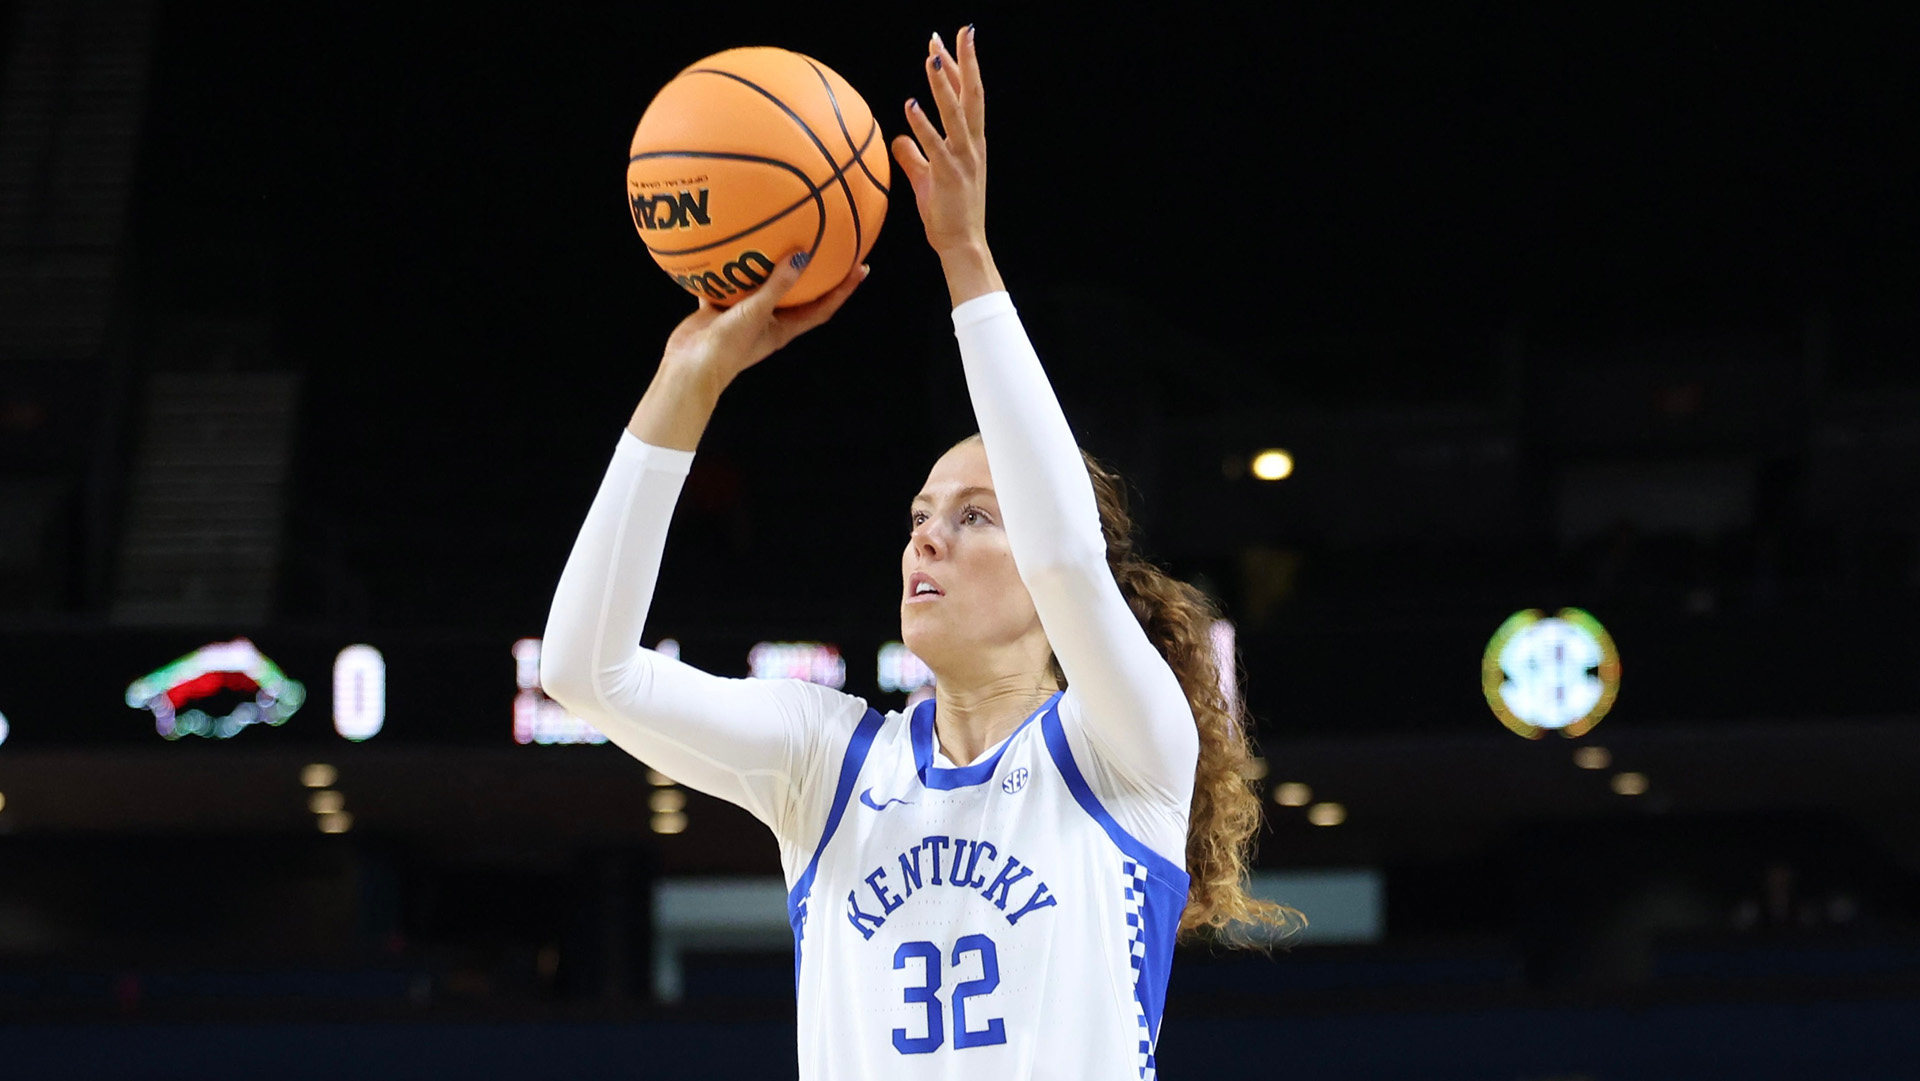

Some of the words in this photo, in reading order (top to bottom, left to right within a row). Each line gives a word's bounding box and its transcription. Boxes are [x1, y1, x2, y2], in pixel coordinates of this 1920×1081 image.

[630, 188, 711, 230] NCAA
[665, 250, 775, 299] Wils
[1003, 769, 1028, 794] SEC
[847, 836, 1057, 941] KENTUCKY
[892, 934, 1007, 1055] 32
